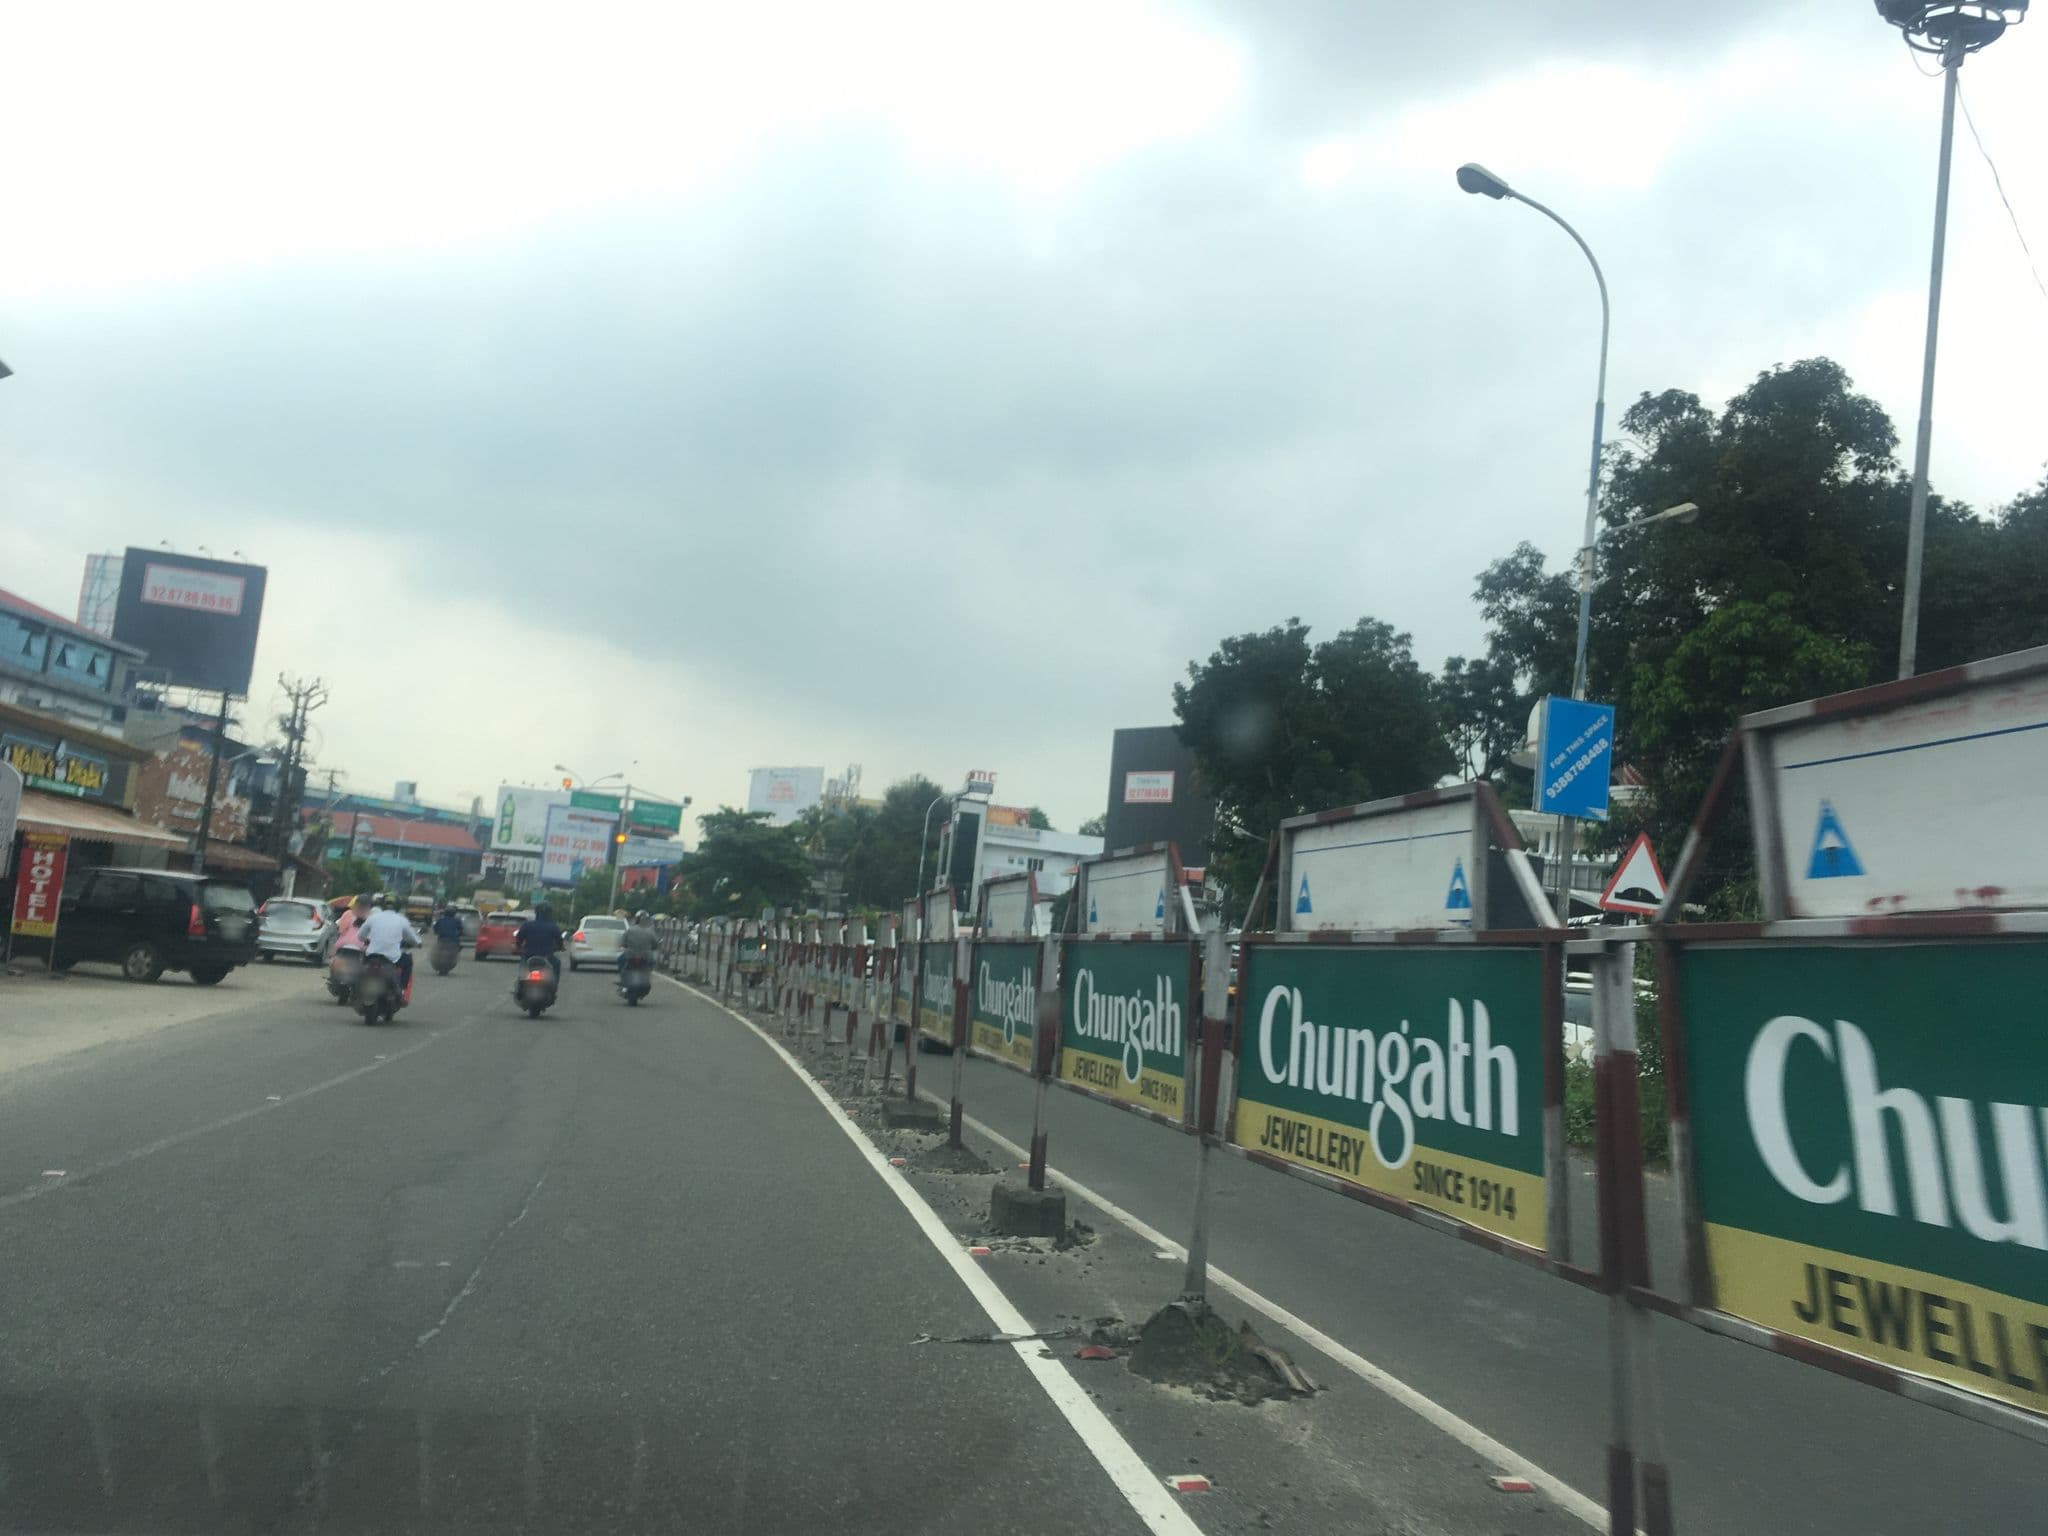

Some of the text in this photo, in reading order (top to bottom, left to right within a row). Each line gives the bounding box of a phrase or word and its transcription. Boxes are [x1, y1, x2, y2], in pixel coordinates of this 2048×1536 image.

[1546, 738, 1608, 798] 9388788488
[1550, 714, 1608, 769] FOR THIS SPACE
[27, 851, 54, 921] HOTEL
[978, 960, 1034, 1046] Chungath
[1074, 968, 1181, 1083] Chungath
[1073, 1057, 1178, 1106] JEWELLERY SINCE 1914
[1258, 984, 1519, 1170] Chungath
[1261, 1114, 1517, 1220] JEWELLERY SINCE 1914
[1744, 1015, 2048, 1252] Chu
